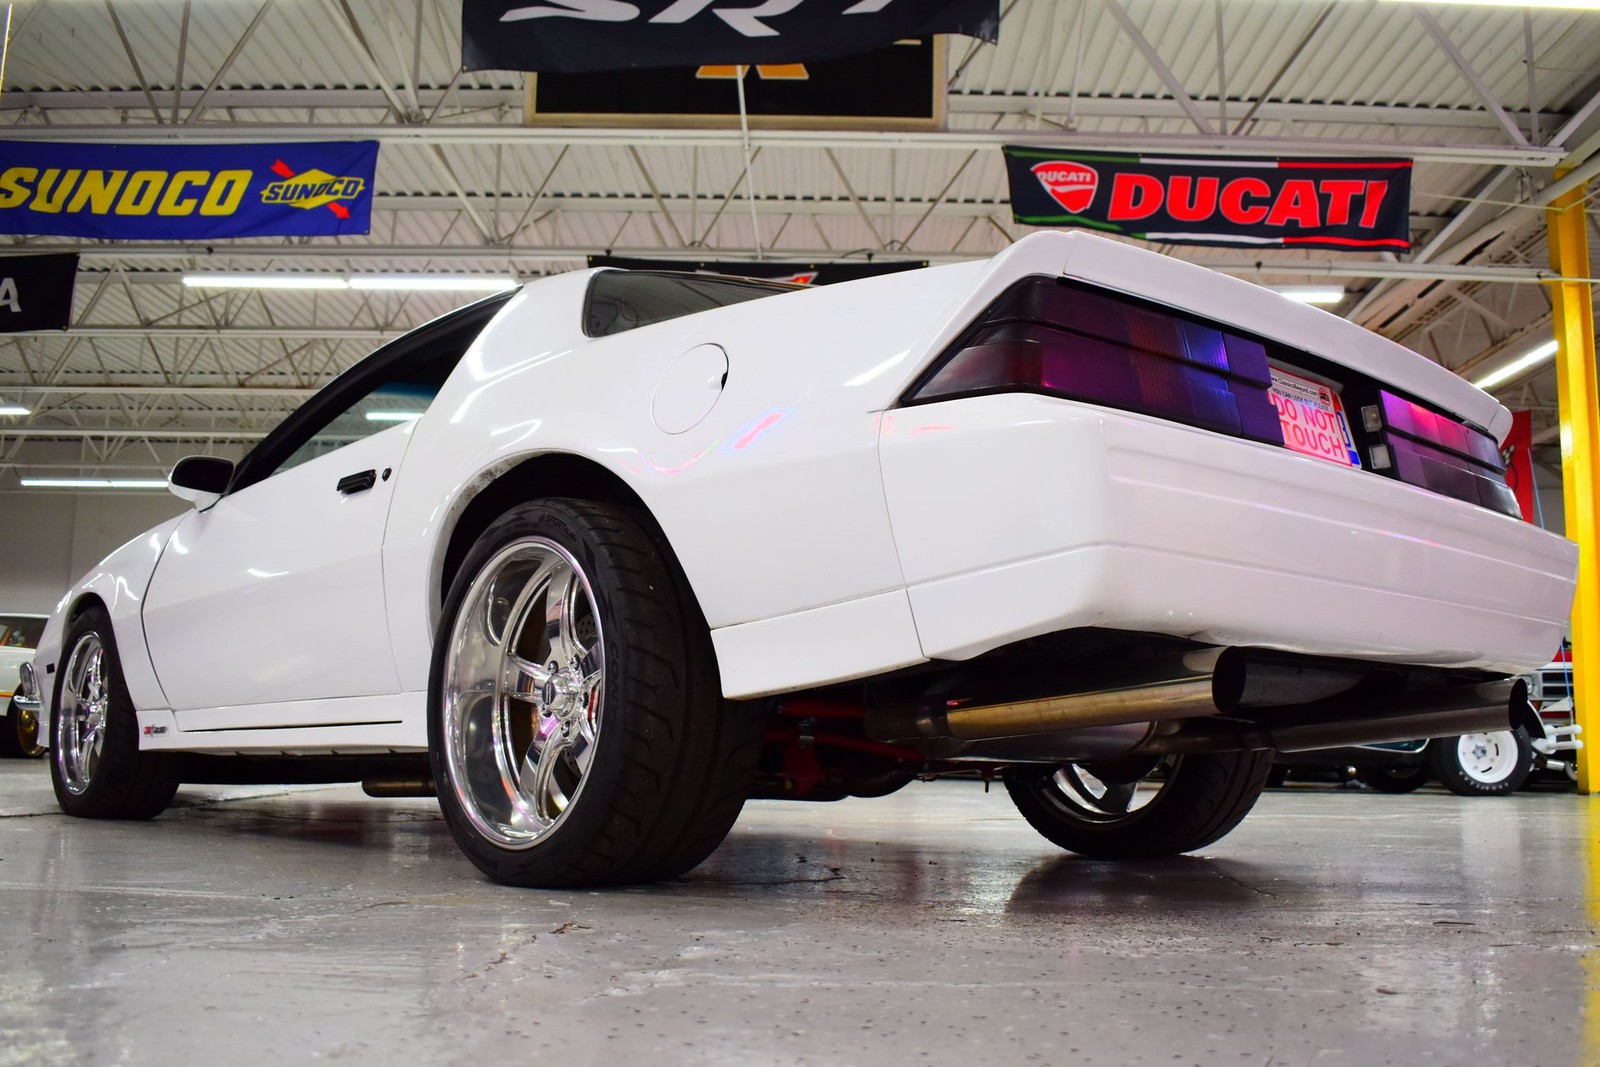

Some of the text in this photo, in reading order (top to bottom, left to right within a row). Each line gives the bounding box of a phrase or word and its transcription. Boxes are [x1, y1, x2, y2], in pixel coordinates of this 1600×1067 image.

[0, 166, 253, 217] SUNOCO
[264, 177, 361, 202] SUNOCO
[1037, 170, 1091, 183] DUCATI
[1107, 172, 1389, 229] DUCATI
[1272, 393, 1298, 421] DO
[1301, 403, 1336, 434] NOT
[1280, 419, 1345, 459] TOUCH
